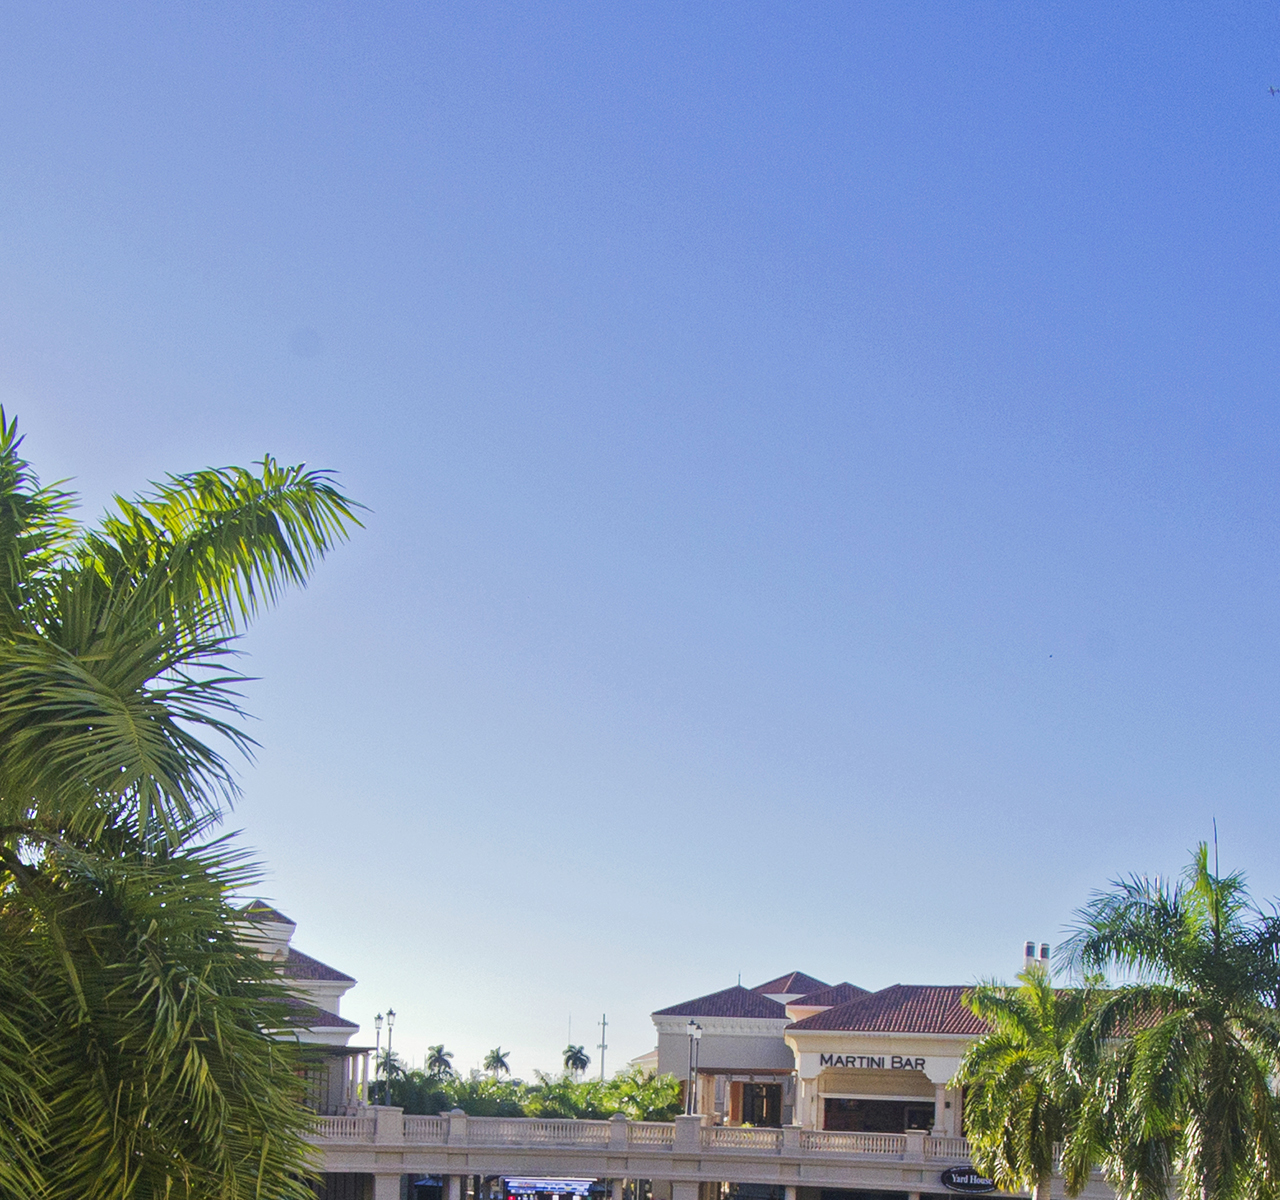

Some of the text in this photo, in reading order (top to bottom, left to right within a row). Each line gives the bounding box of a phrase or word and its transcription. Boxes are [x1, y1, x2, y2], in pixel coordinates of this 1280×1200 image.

[820, 1053, 926, 1070] MARTINI BAR
[951, 1173, 993, 1185] Yard House
